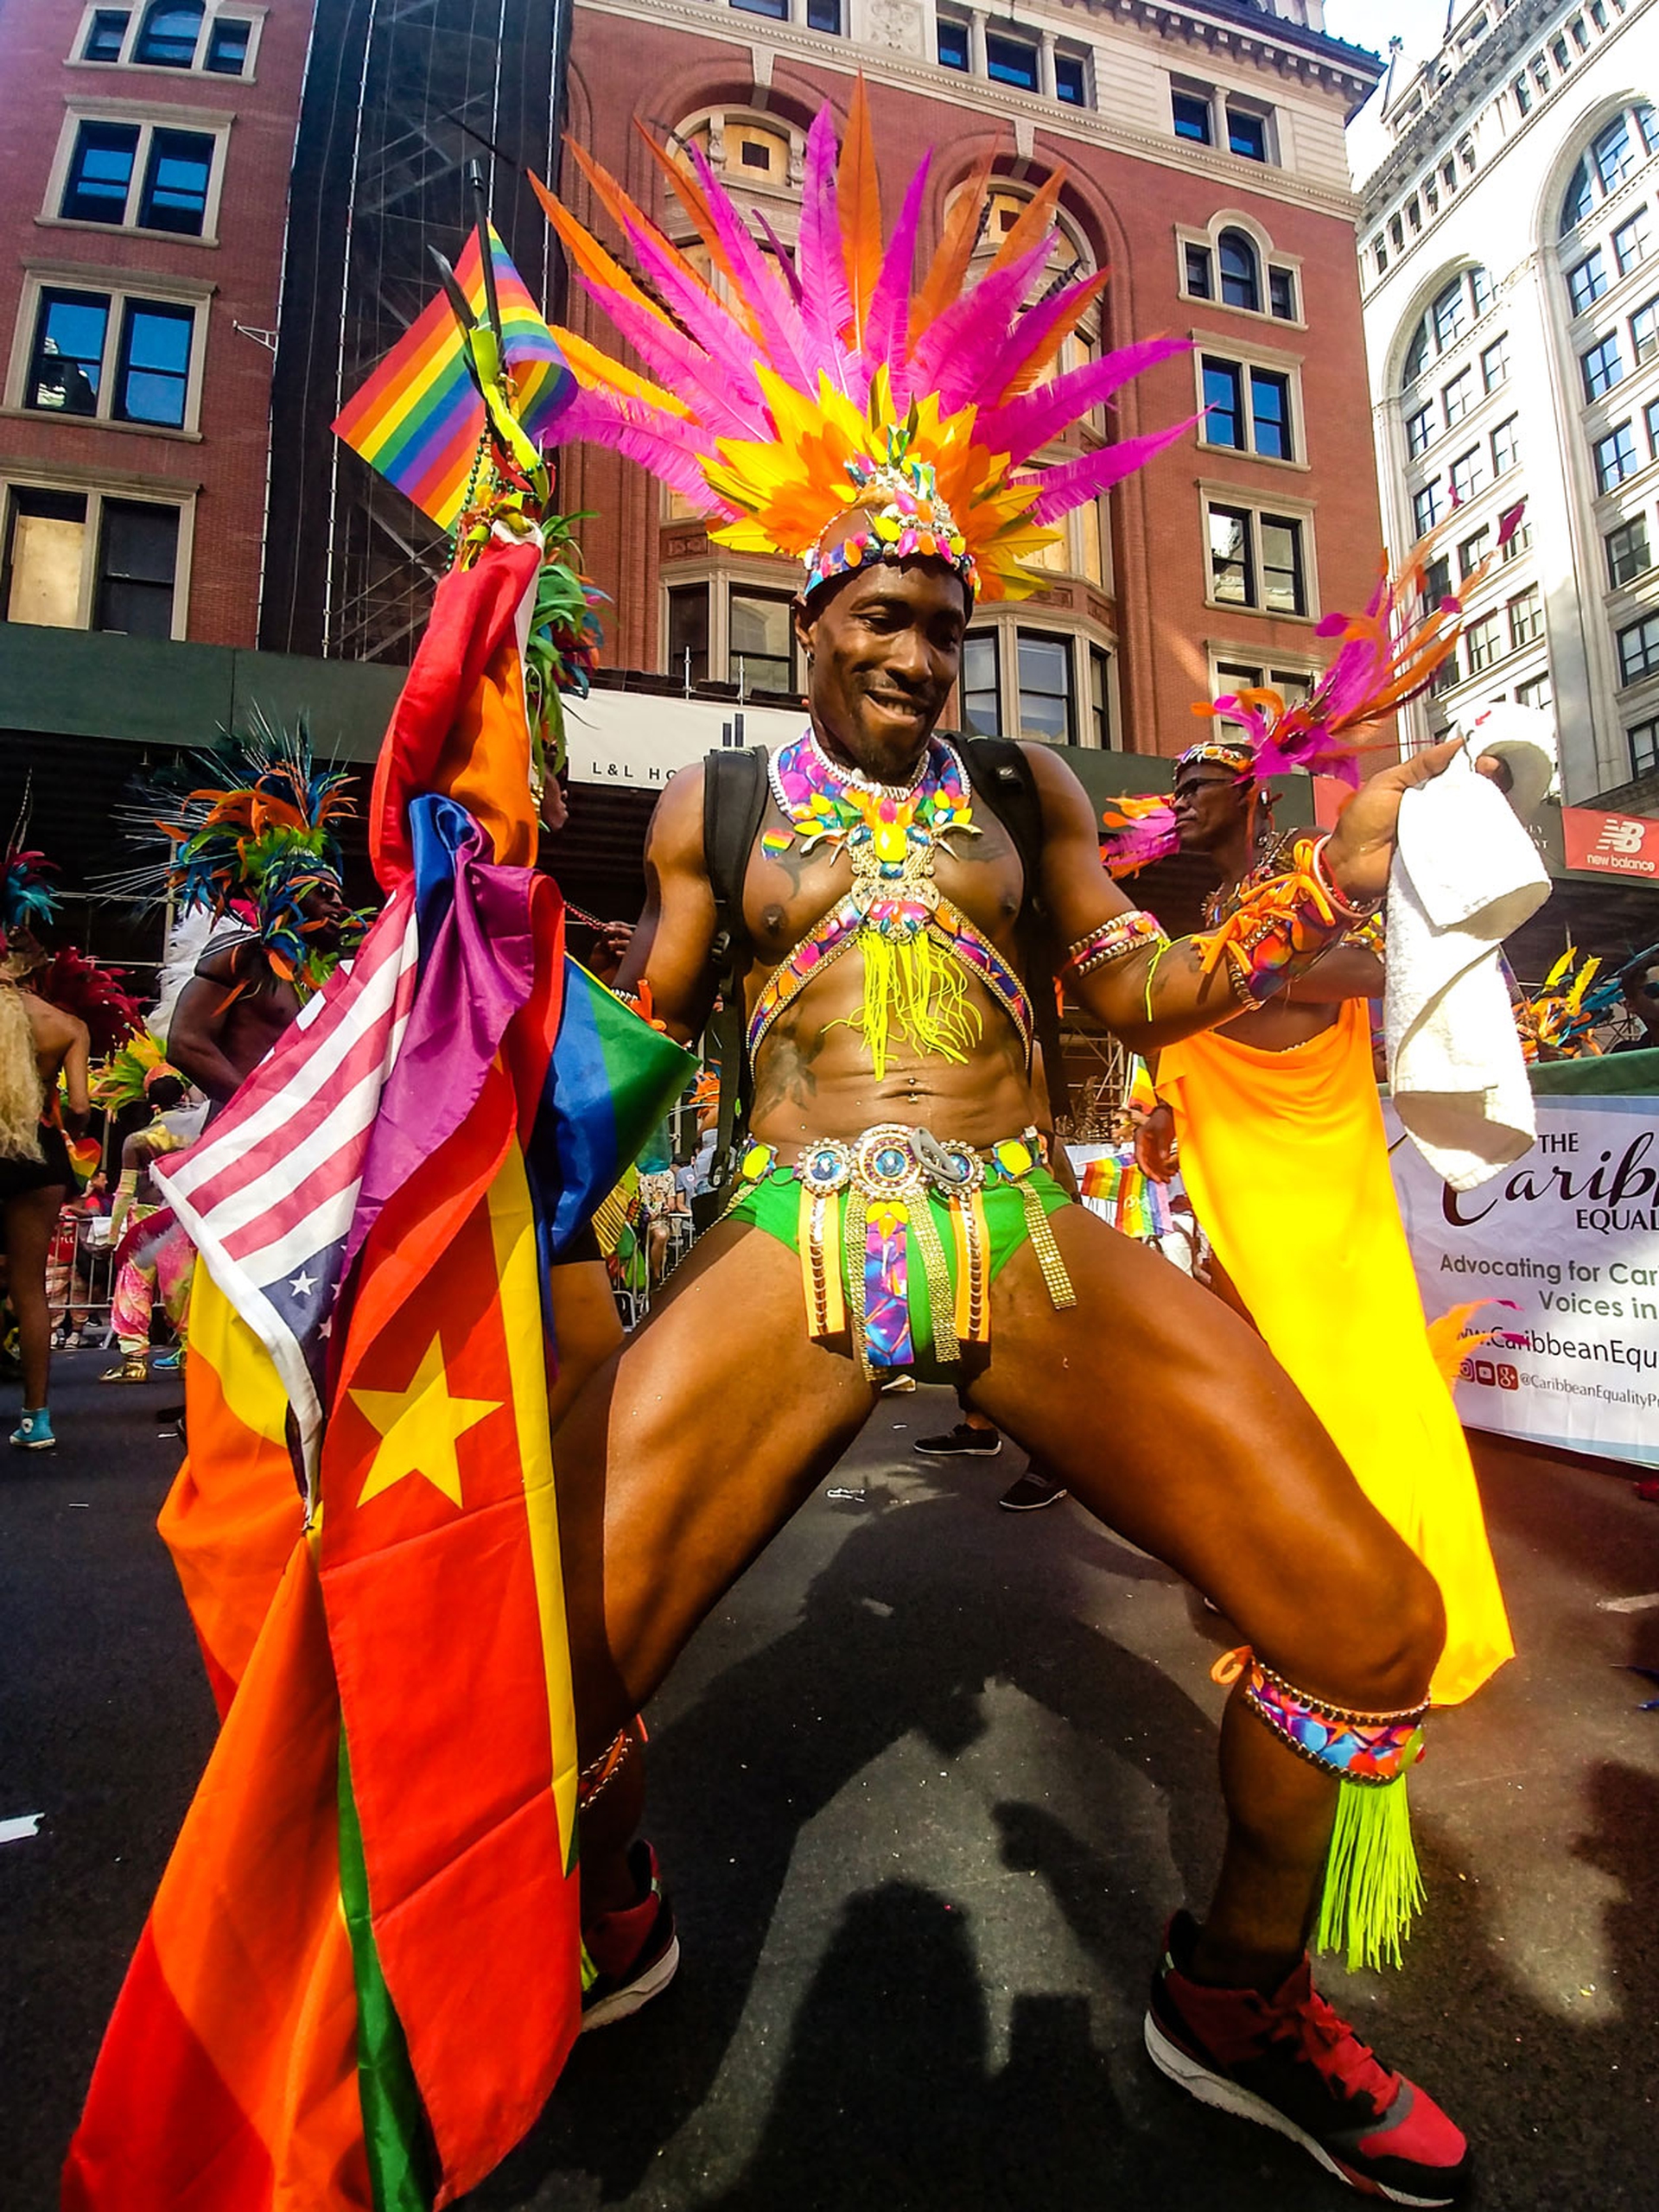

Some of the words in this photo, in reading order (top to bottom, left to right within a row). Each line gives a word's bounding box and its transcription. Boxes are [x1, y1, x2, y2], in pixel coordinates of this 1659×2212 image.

[593, 761, 633, 778] L&L
[1586, 854, 1610, 866] new
[1611, 855, 1656, 872] balance
[1538, 1133, 1580, 1154] THE
[1444, 1132, 1659, 1226] Carib
[1577, 1209, 1659, 1235] EQUAL
[1440, 1254, 1561, 1285] Advocating
[1568, 1261, 1600, 1282] for
[1609, 1262, 1659, 1286] Car
[1539, 1290, 1624, 1318] Voices
[1631, 1297, 1657, 1320] in
[1520, 1372, 1659, 1410] @CaribbeanEqualityP
